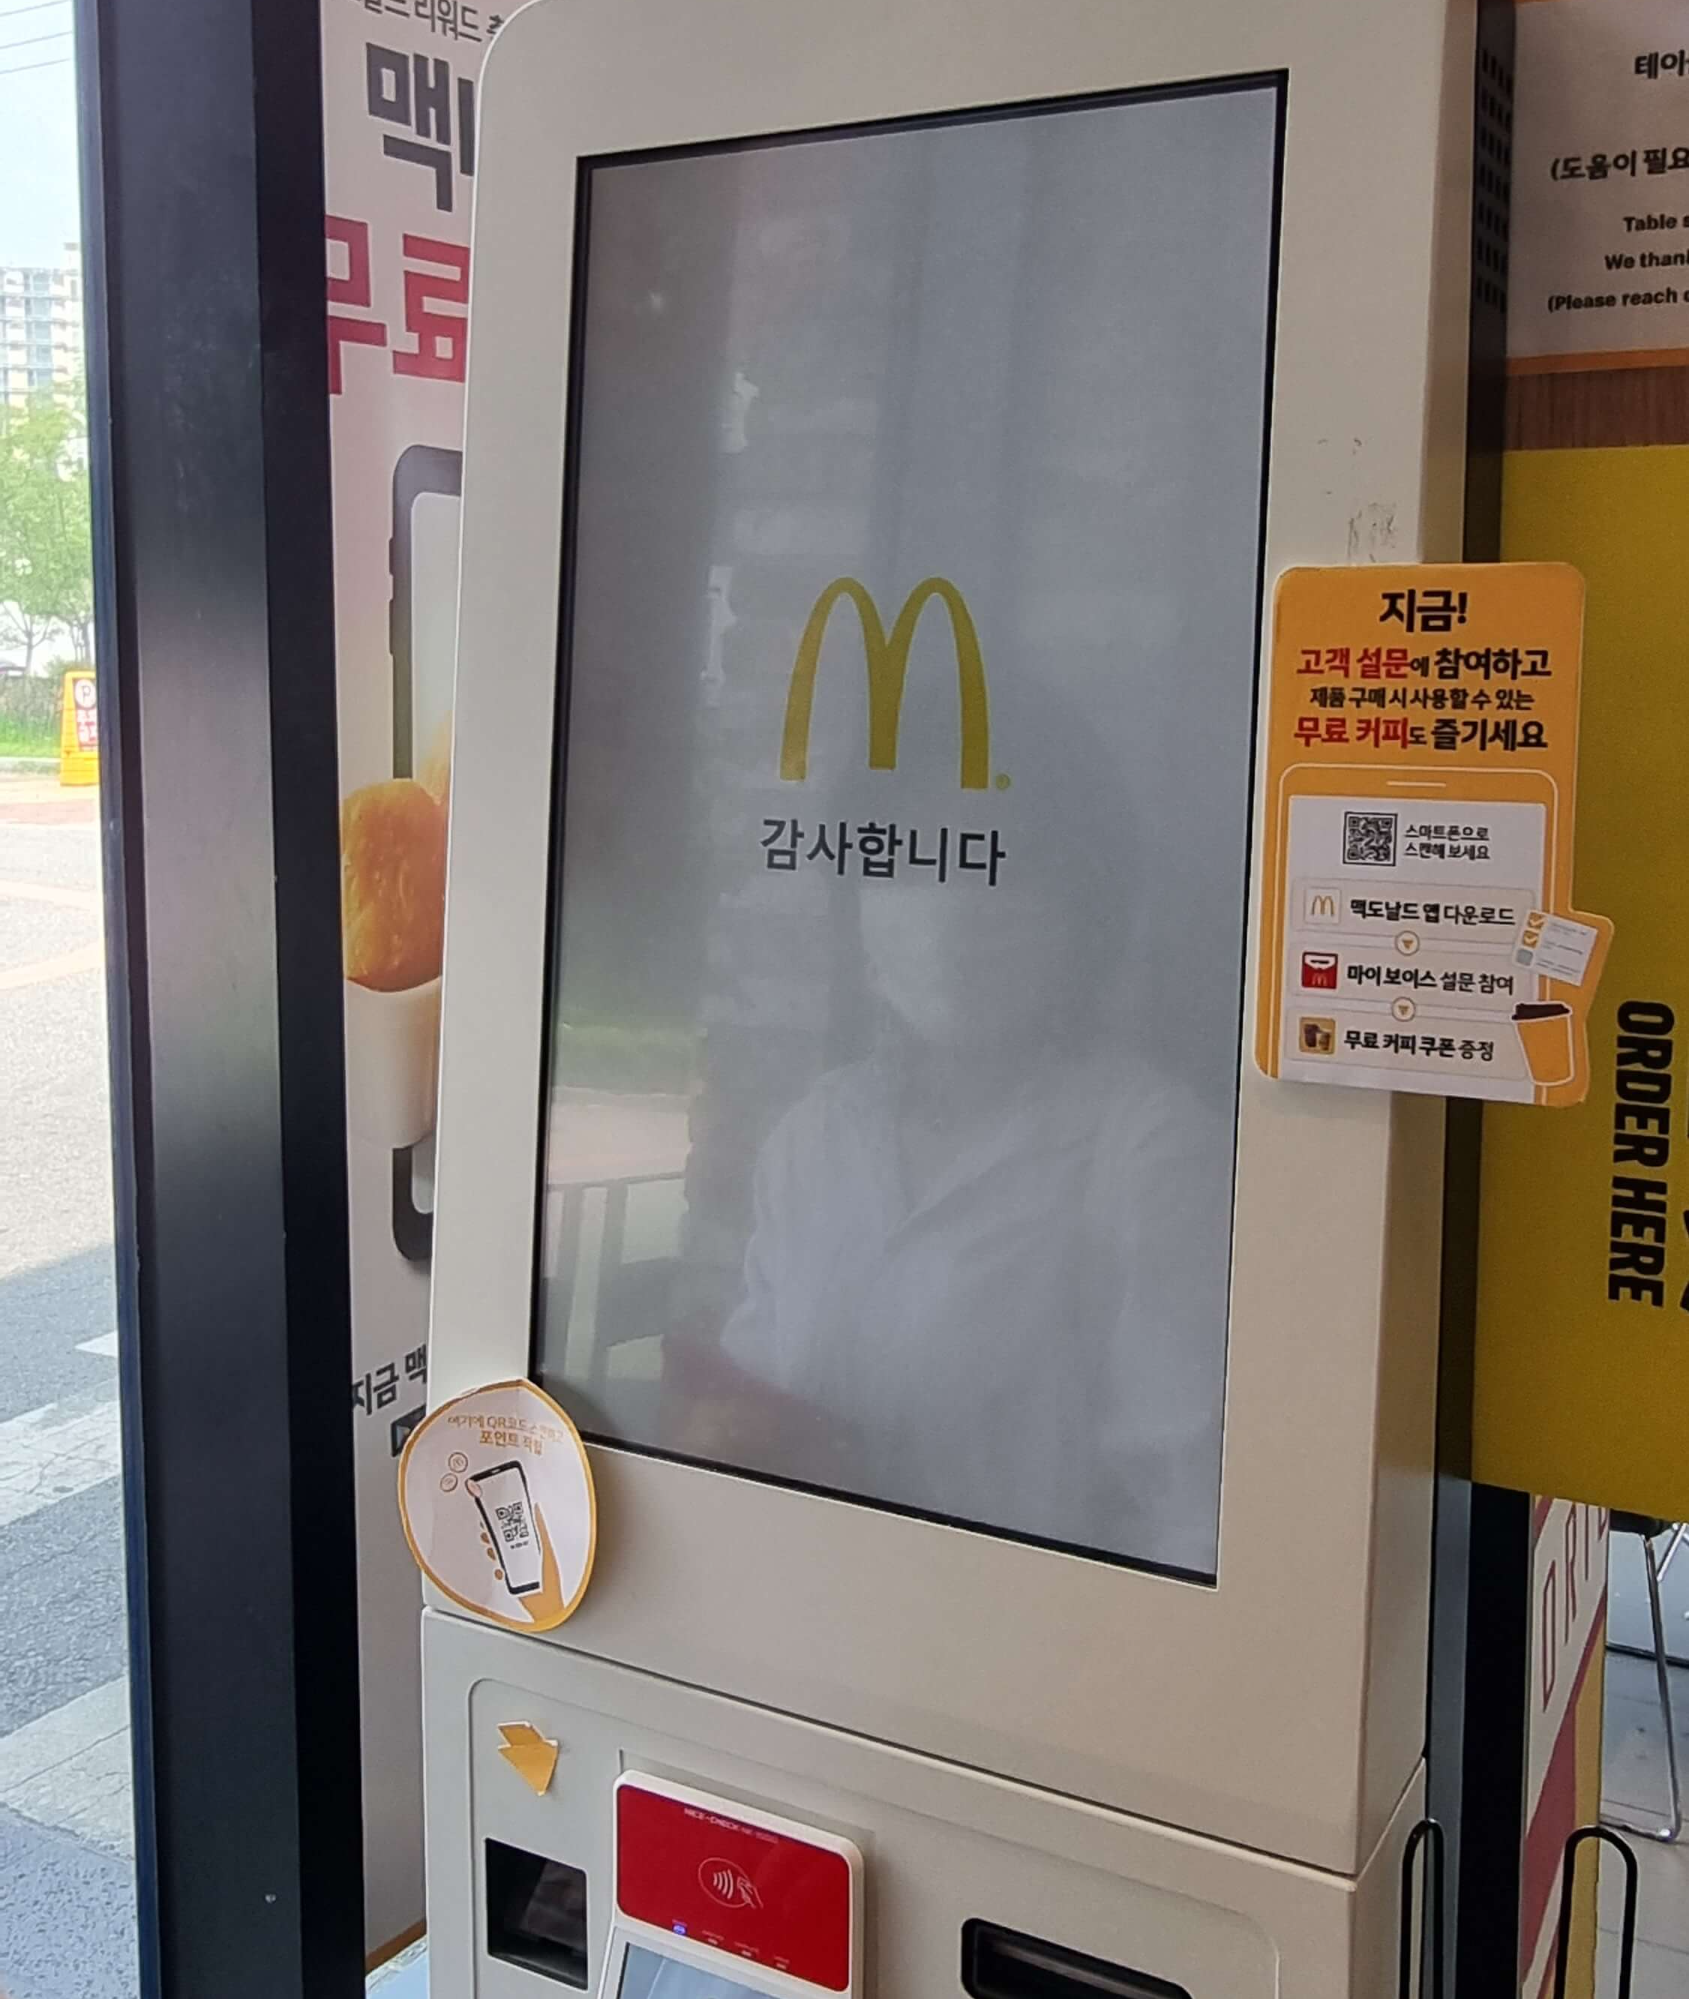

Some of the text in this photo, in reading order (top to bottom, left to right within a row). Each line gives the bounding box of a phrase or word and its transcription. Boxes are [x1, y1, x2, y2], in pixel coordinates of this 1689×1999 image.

[1634, 49, 1689, 79] 테이
[1550, 149, 1636, 181] (도움이
[1623, 215, 1677, 232] Table
[1604, 253, 1635, 270] We
[1548, 293, 1617, 313] (Please
[1622, 286, 1678, 307] reach
[1379, 589, 1468, 633] 지금!
[1296, 647, 1552, 681] 고객 설문에 참여하고
[1310, 687, 1346, 708] 제품
[1348, 687, 1386, 709] 구매
[1410, 688, 1469, 710] 사용할
[1470, 689, 1492, 710] 수
[1495, 689, 1535, 711] 있는
[1294, 717, 1548, 752] 무료 커피도 즐기세요
[1403, 824, 1491, 841] 스마트폰으로
[760, 819, 1006, 887] 감사합니다
[1447, 844, 1491, 860] 보세요
[1350, 899, 1420, 922] 맥도날드
[1444, 904, 1516, 926] 다운로드
[1347, 965, 1514, 996] 마이 보이스 설문 참여
[1344, 1030, 1495, 1062] 무료 커피 쿠폰 증정
[1607, 1000, 1676, 1308] ORDER HERE
